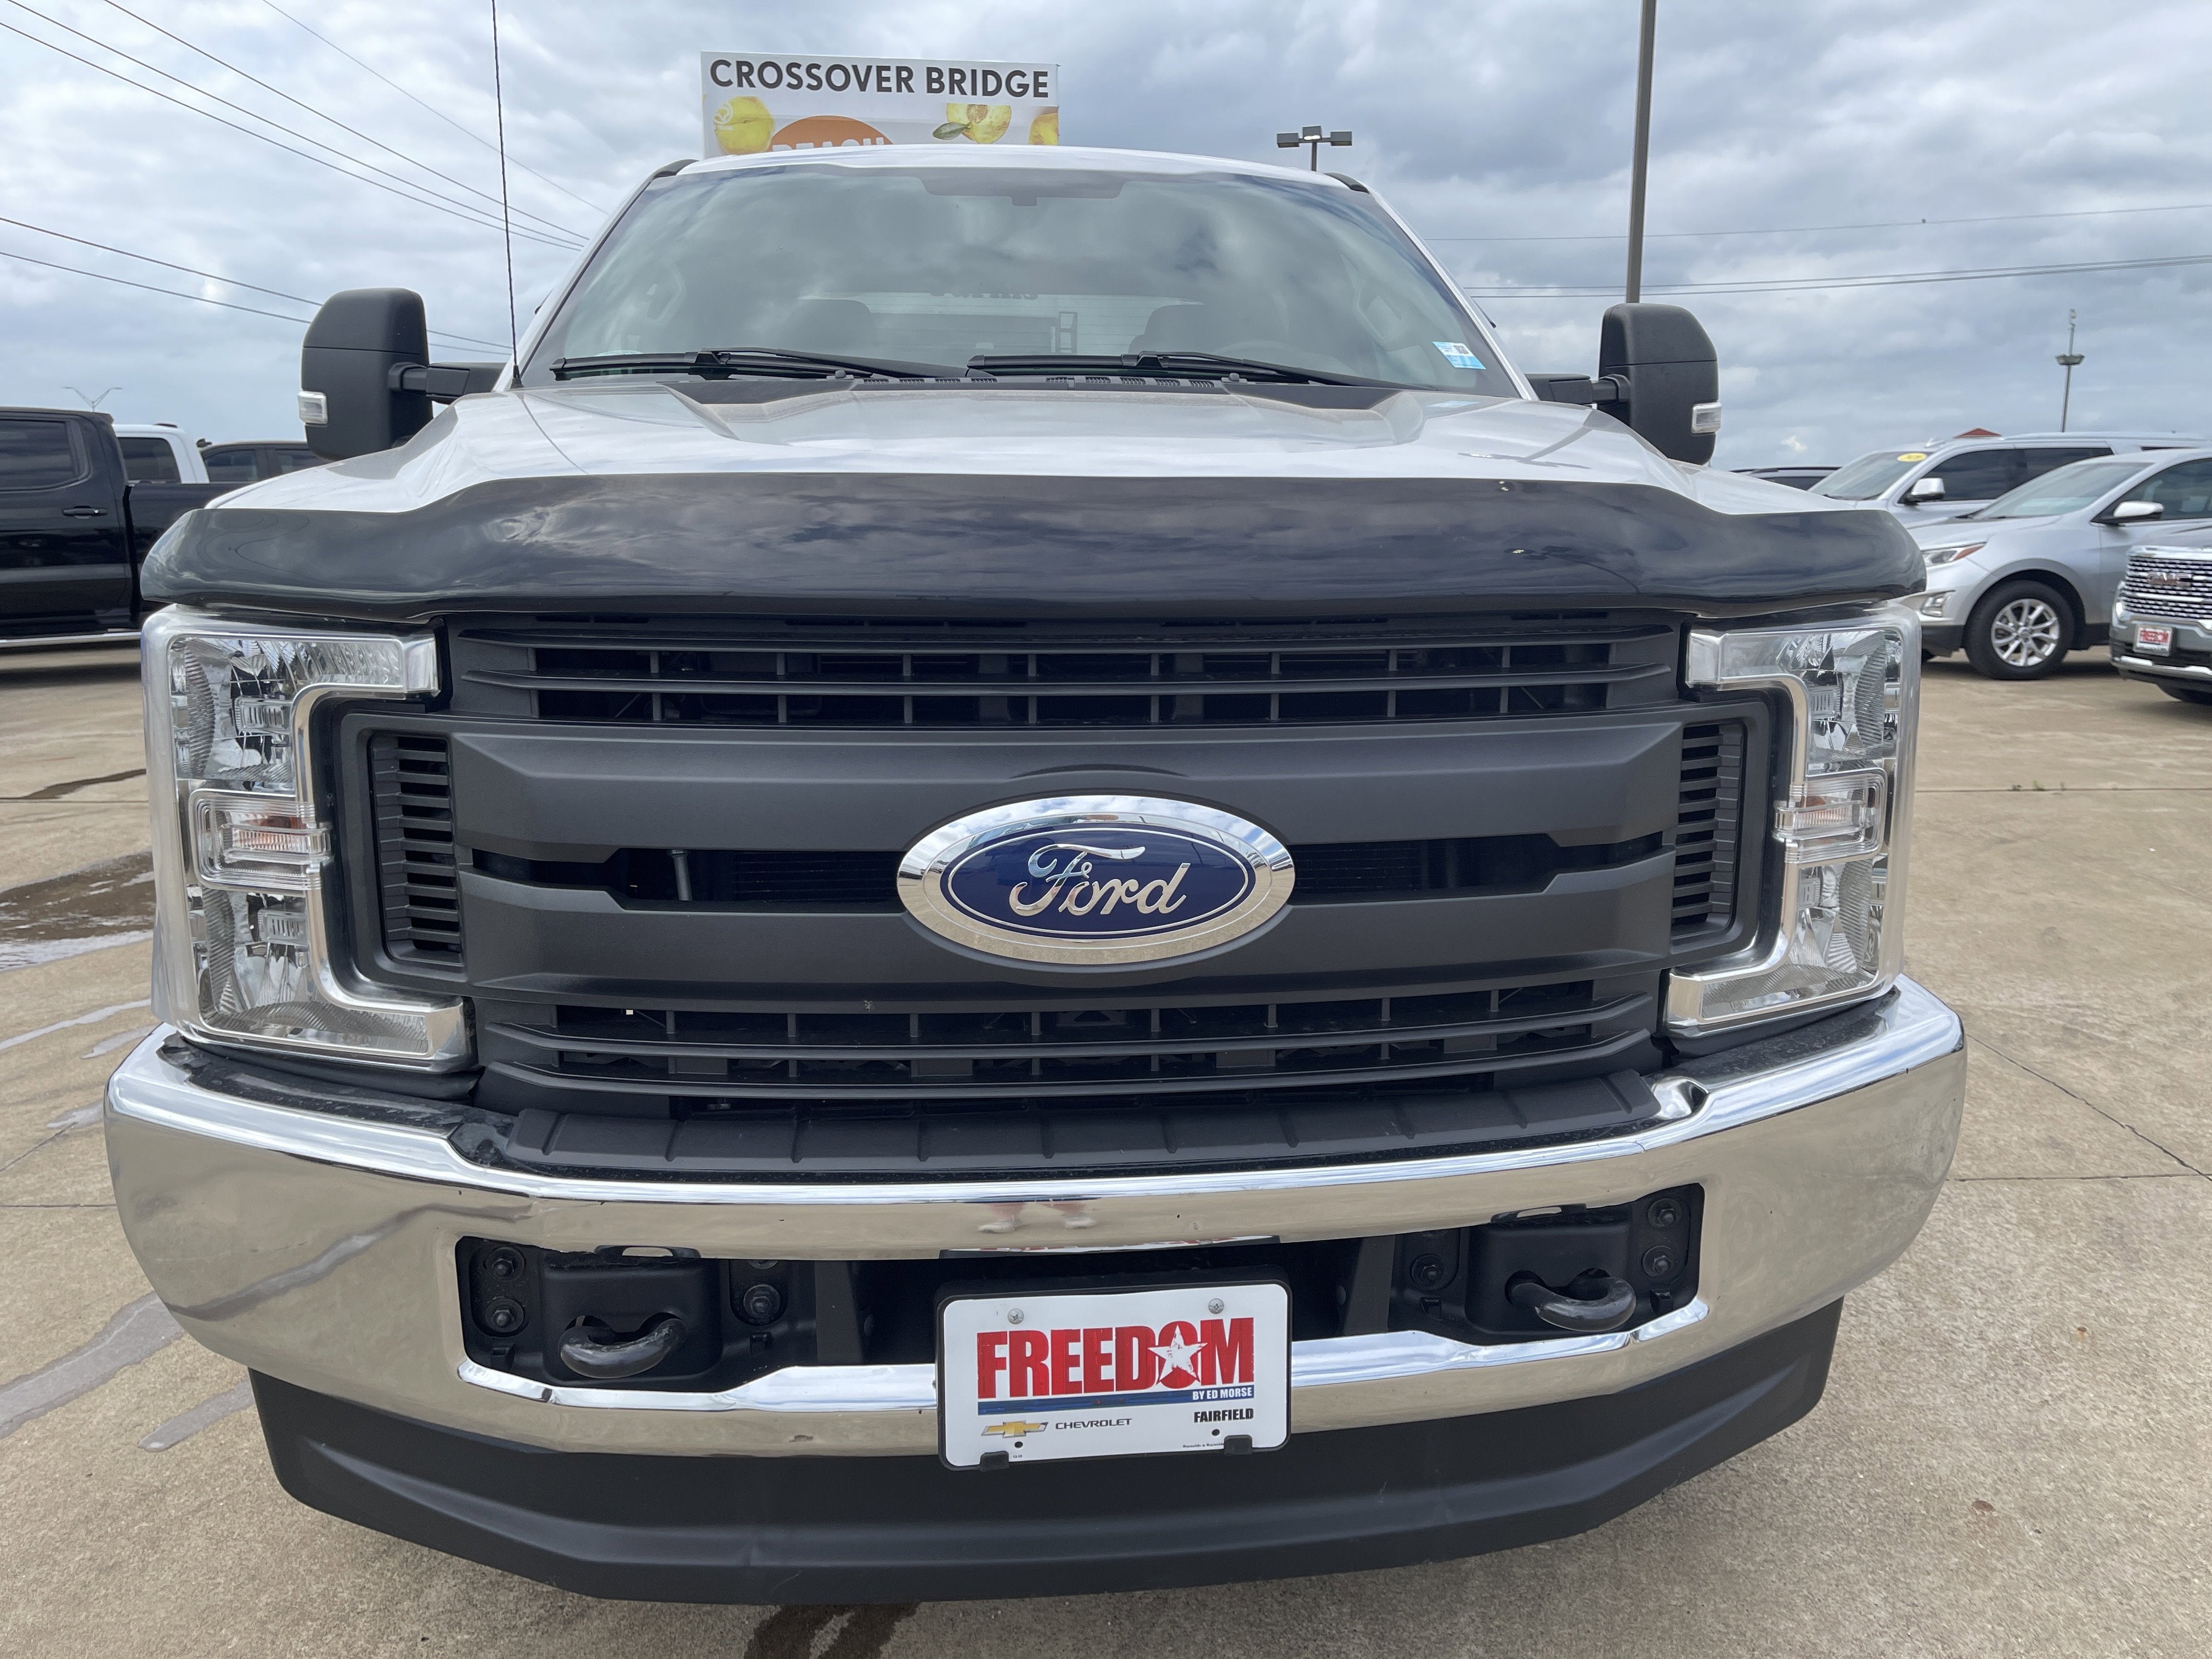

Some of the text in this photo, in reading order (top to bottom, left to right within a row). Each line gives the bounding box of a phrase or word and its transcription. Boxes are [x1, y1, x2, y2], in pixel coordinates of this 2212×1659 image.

[710, 59, 1048, 98] CROSSOVER BRIDGE
[1009, 843, 1191, 917] Ford
[977, 1317, 1254, 1399] FREEDOM
[1192, 1387, 1252, 1401] BY ED MORSE
[1056, 1418, 1132, 1430] CHEVROLET
[1194, 1408, 1254, 1423] FAIRFIELD
